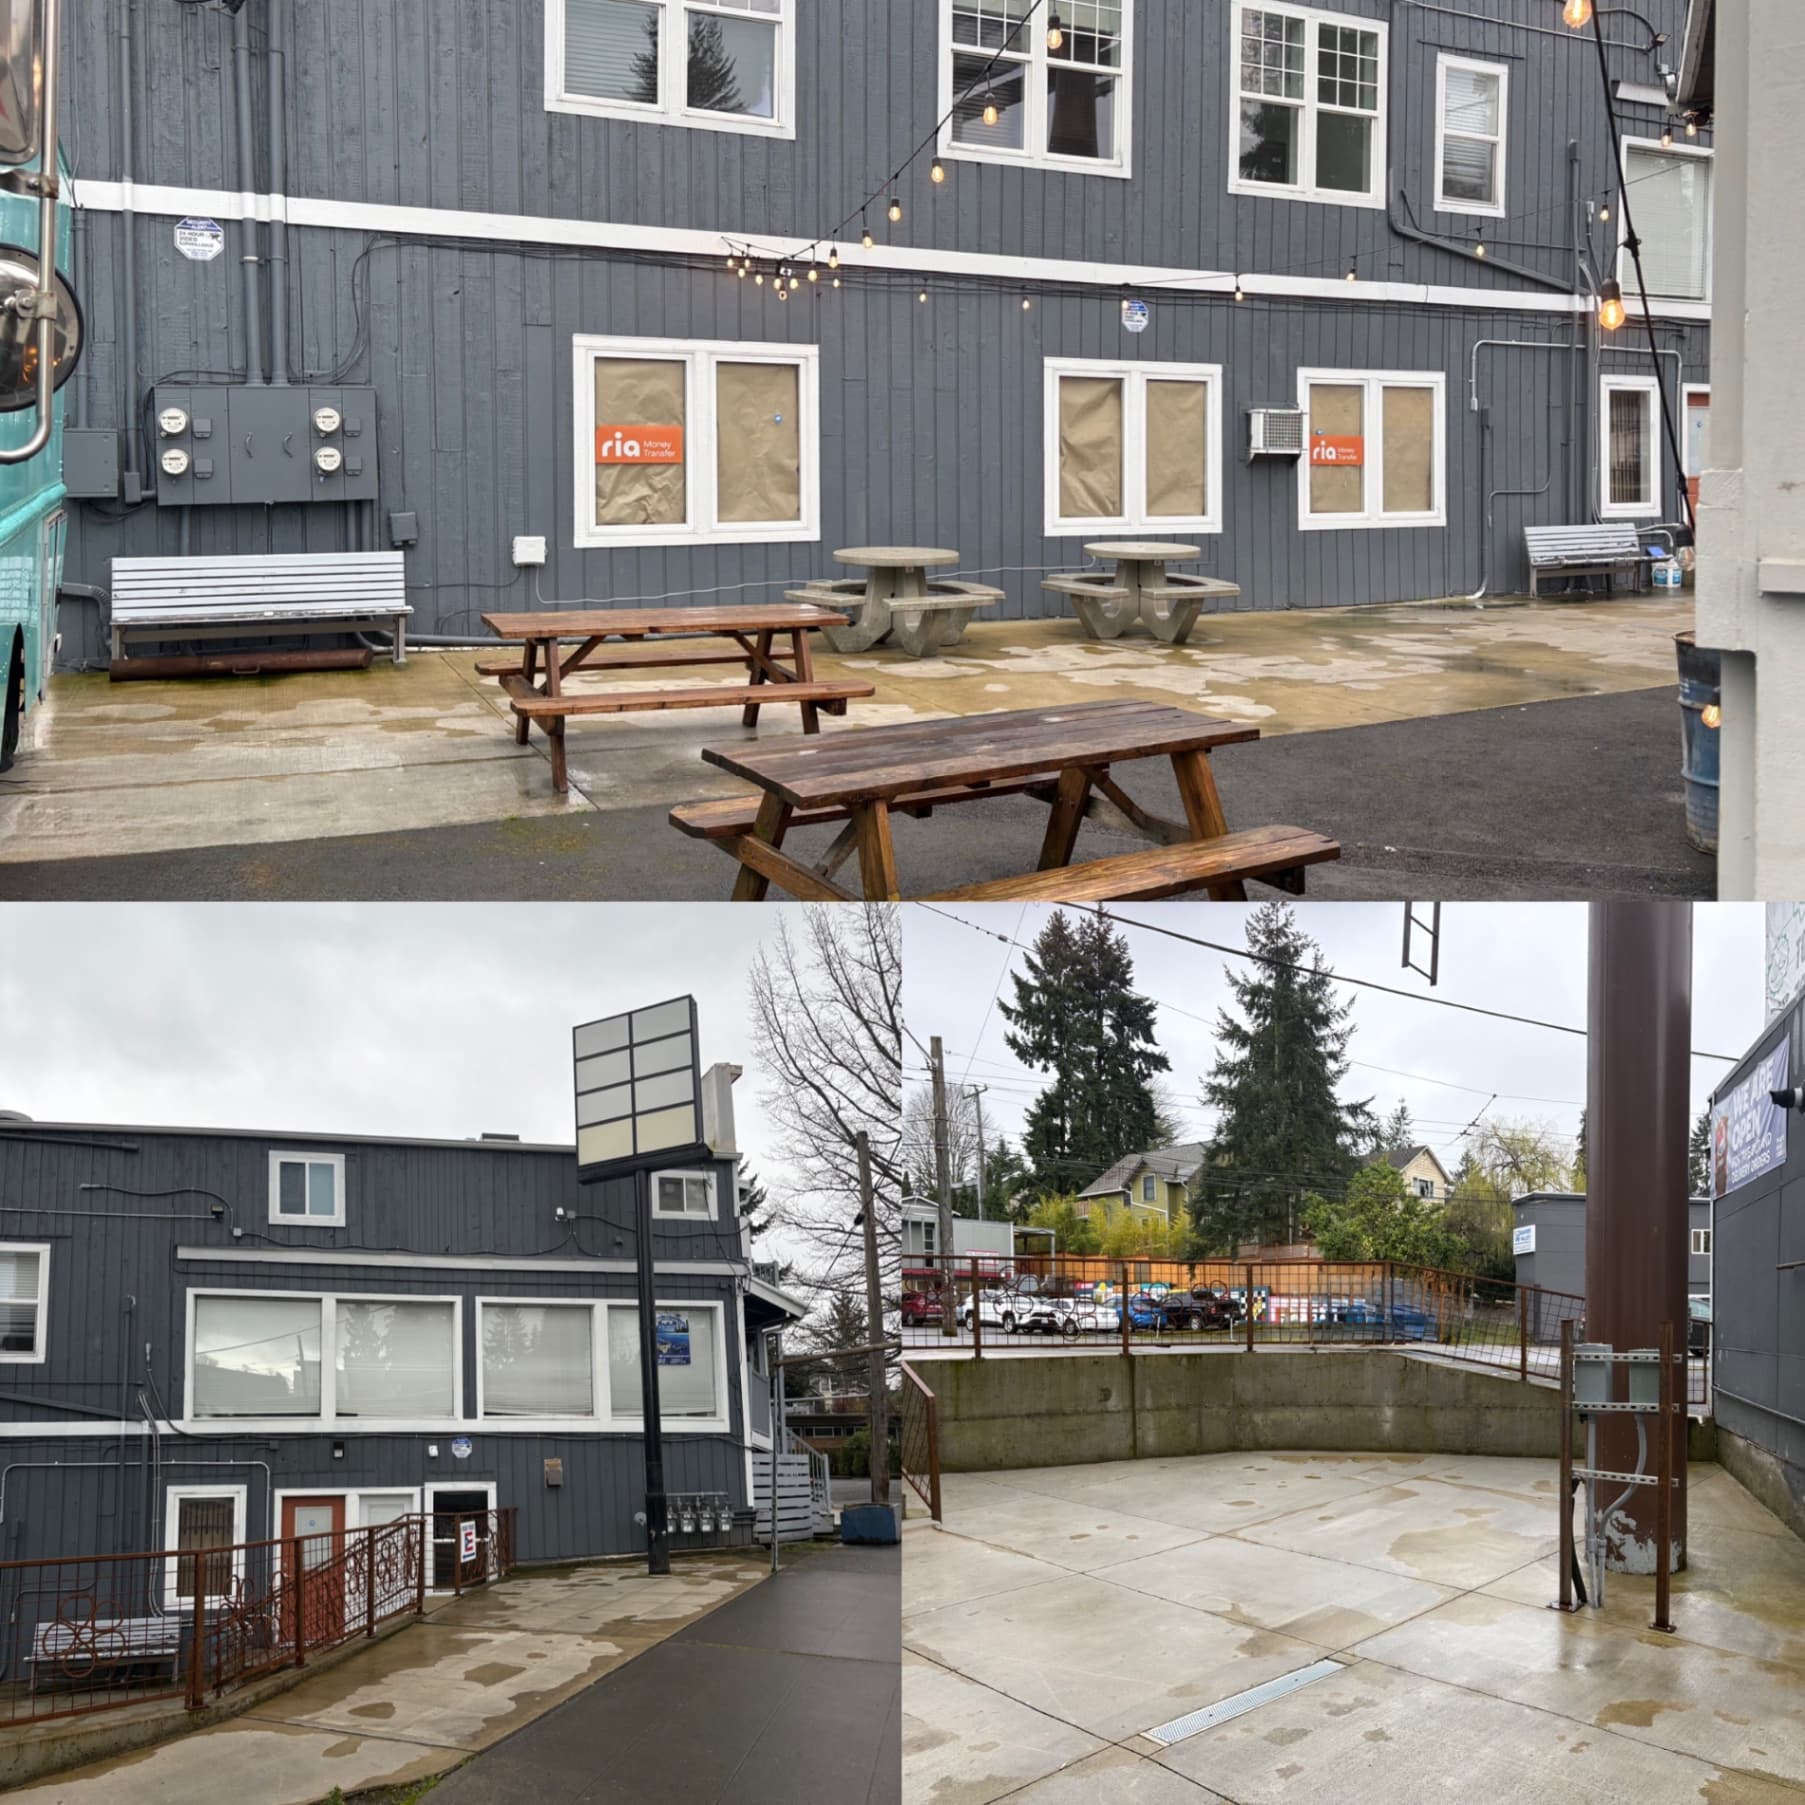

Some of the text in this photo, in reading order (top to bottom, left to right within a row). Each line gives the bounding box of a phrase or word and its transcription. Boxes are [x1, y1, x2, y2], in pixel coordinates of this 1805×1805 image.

[601, 431, 640, 457] ria
[643, 440, 672, 450] Money
[643, 449, 676, 457] Transfer
[1312, 440, 1337, 460] ria
[1733, 1059, 1774, 1120] WE ARE
[1731, 1104, 1762, 1151] OPEN
[1750, 1149, 1771, 1173] ORDERS
